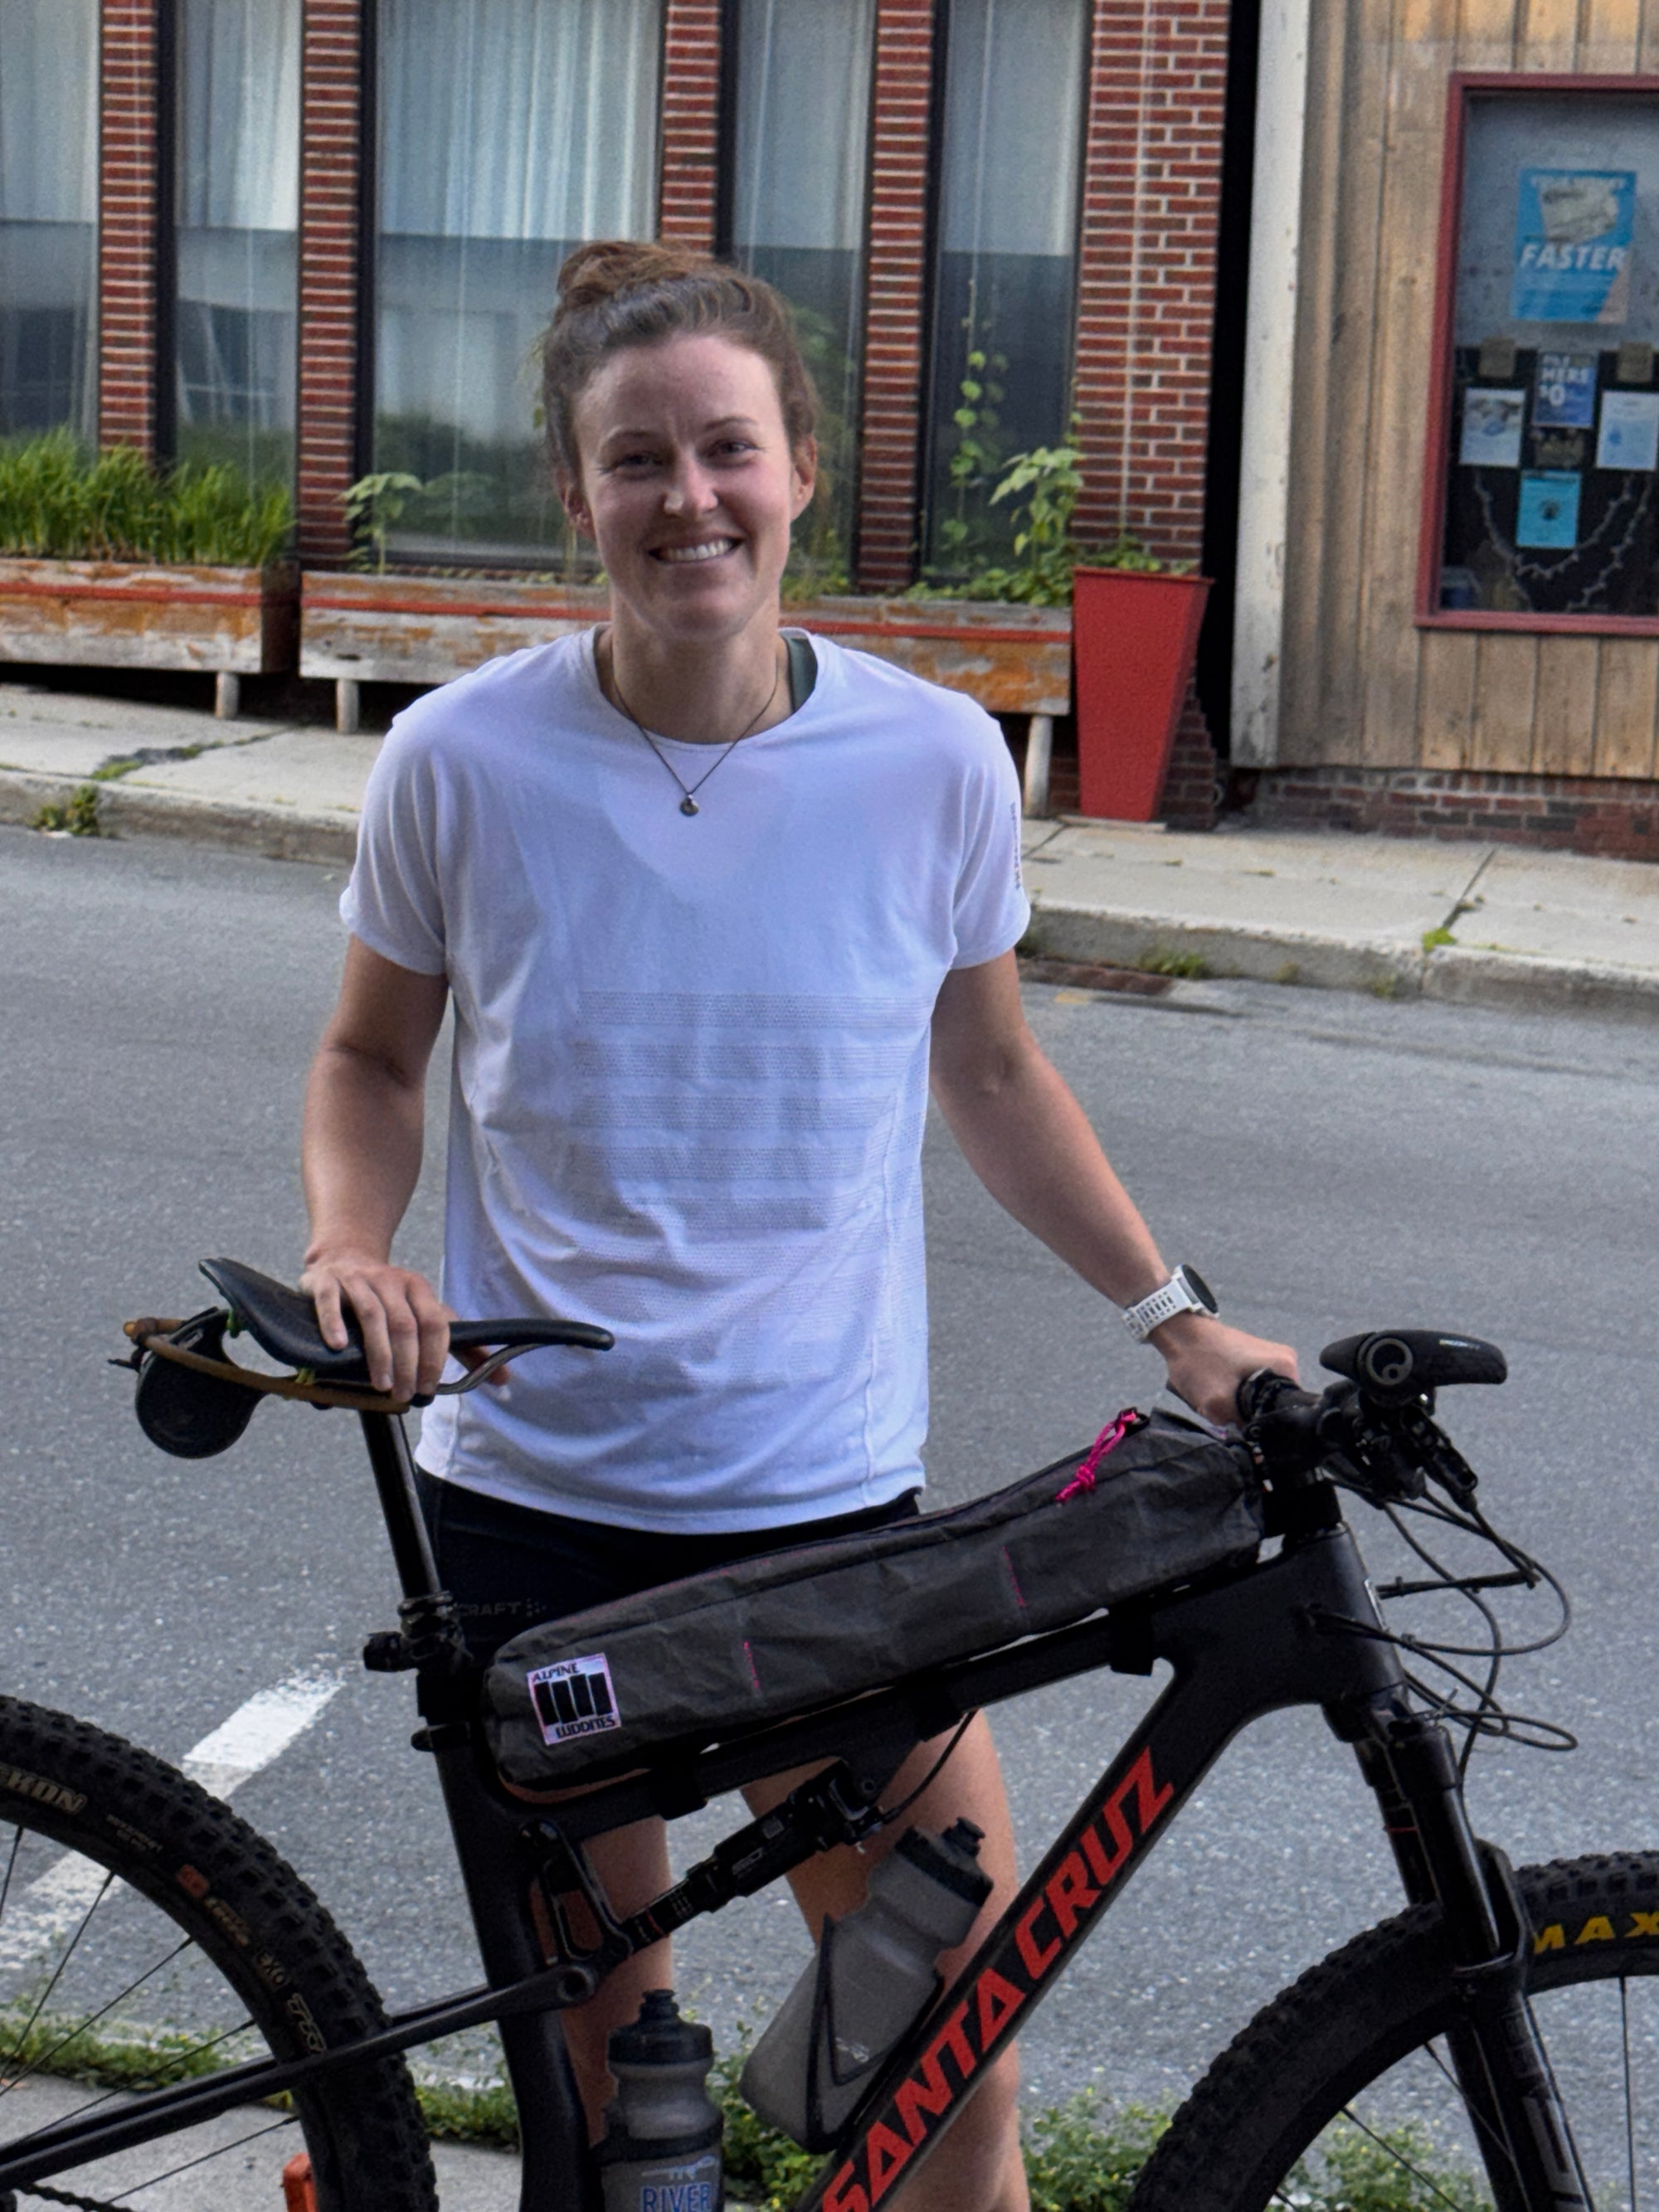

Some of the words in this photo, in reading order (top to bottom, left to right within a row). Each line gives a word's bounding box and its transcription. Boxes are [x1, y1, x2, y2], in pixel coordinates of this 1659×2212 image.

[1518, 243, 1626, 270] FASTER
[533, 1662, 580, 1682] ALPINE
[821, 1966, 1026, 2212] SANTA
[1014, 1746, 1173, 1981] CRUZ
[641, 2180, 713, 2212] RIVER
